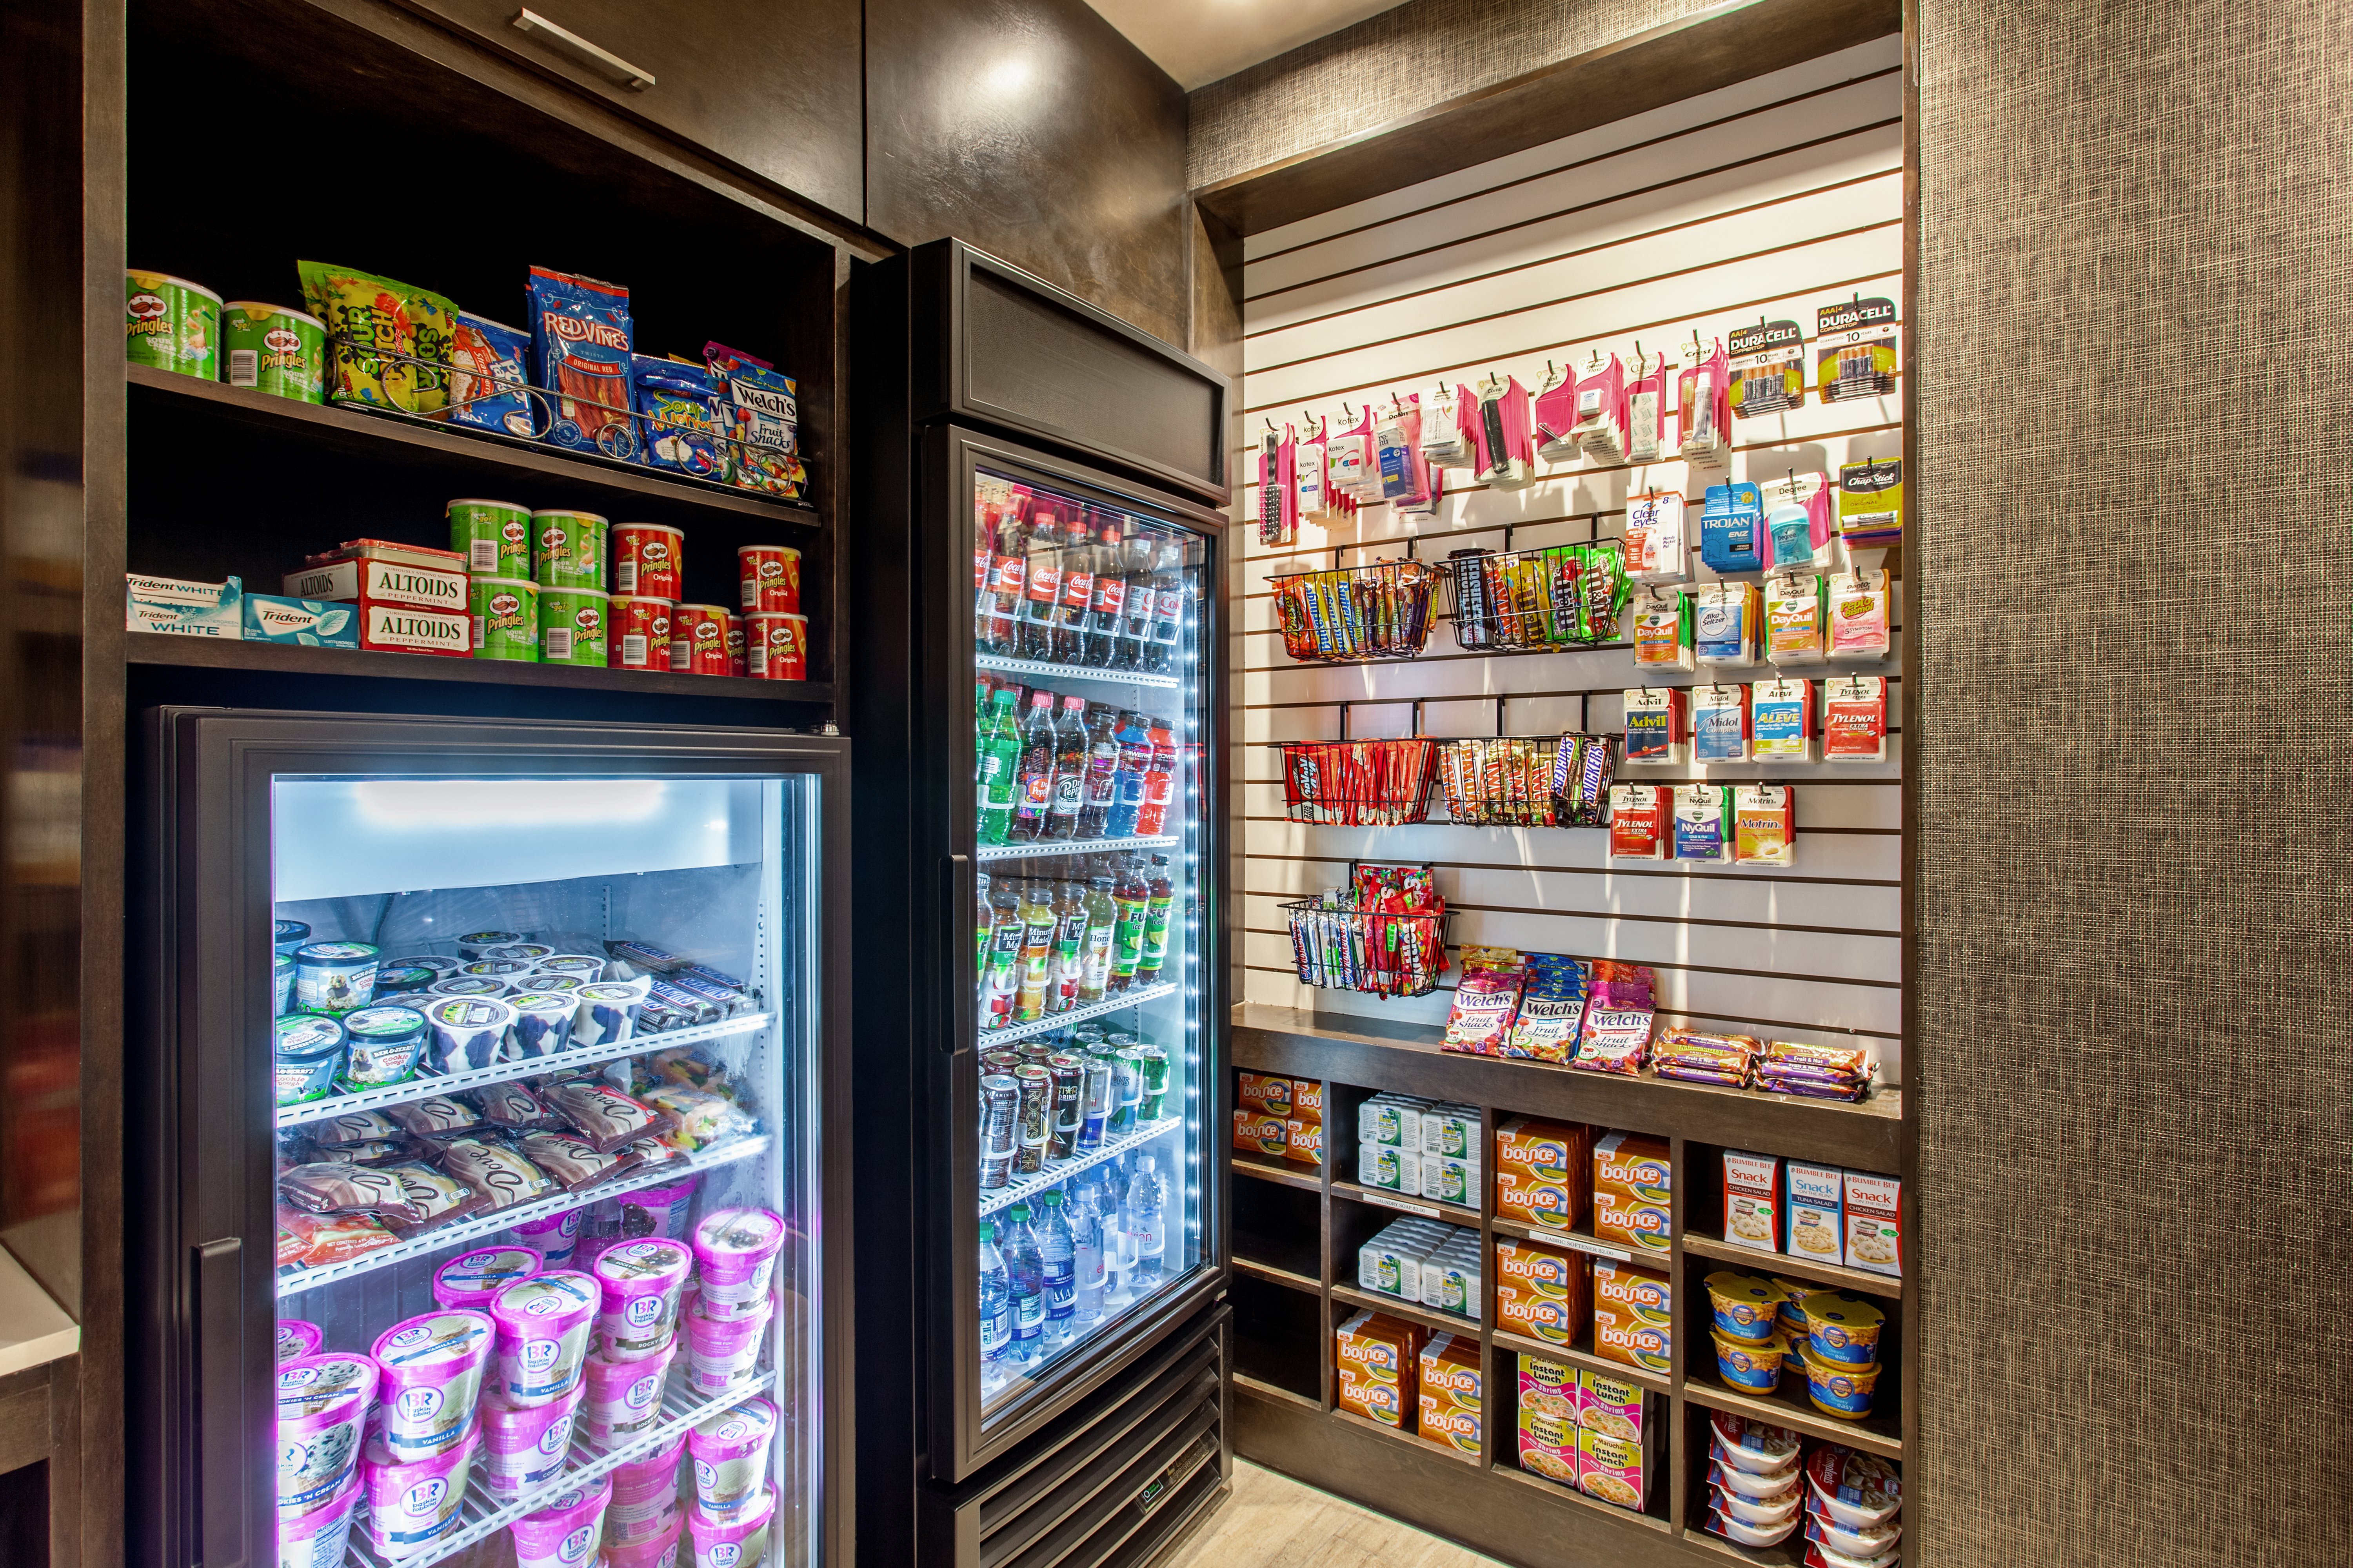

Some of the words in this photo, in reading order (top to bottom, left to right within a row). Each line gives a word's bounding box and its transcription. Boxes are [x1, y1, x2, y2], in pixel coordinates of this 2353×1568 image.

[1819, 305, 1891, 328] DURACELL
[1820, 322, 1857, 332] COPPERTOP
[349, 308, 379, 374] SOUR
[1731, 328, 1796, 350] DURACELL
[1846, 332, 1860, 342] 10
[1731, 344, 1764, 354] COPPERTOP
[261, 354, 307, 372] Pringles
[574, 358, 600, 372] ORIGINAL
[1755, 354, 1767, 364] 10
[654, 391, 705, 416] Sour
[736, 386, 796, 416] Welch's
[760, 424, 785, 437] Fruit
[751, 432, 791, 449] Snacks
[1779, 485, 1806, 494] Degree
[1633, 508, 1659, 520] Clear
[1634, 517, 1658, 528] eyes
[1702, 517, 1750, 528] TROJAN
[540, 546, 571, 566] Pringles
[642, 559, 671, 575] Pringles
[127, 578, 175, 590] Trident
[177, 586, 223, 597] WHITE
[301, 574, 333, 596] ALTOIDS
[379, 572, 458, 598] ALTOIDS
[760, 577, 786, 592] Pringles
[388, 593, 449, 605] PEPPERMINT
[1841, 598, 1874, 612] Pepto-
[139, 611, 178, 621] Trident
[262, 611, 313, 624] Trident
[1845, 604, 1874, 618] Bismol
[487, 615, 524, 633] Pringles
[1703, 617, 1725, 626] Seltzer
[1771, 613, 1813, 624] DayQuil
[151, 623, 220, 635] WHITE
[381, 617, 460, 639] ALTOIDS
[1637, 627, 1673, 637] DayQuil
[390, 637, 451, 647] PEPPERMINT
[574, 628, 603, 646] Pringles
[694, 638, 721, 655] Pringles
[769, 644, 795, 659] Pringles
[1628, 716, 1666, 726] Advil
[1758, 713, 1800, 723] ALEVE
[1833, 715, 1876, 723] TYLENOL
[1615, 819, 1653, 828] TYLENOL
[1682, 824, 1715, 833] NyQuil
[1741, 819, 1778, 829] Motrin
[1459, 993, 1511, 1007] Welch's
[1527, 1002, 1580, 1016] Welch's
[1459, 1020, 1494, 1028] Snacks
[1594, 1014, 1651, 1027] Welch's
[1591, 1040, 1630, 1048] Snacks
[1244, 1085, 1283, 1098] bounce
[1379, 1114, 1391, 1123] Ares
[1238, 1123, 1277, 1138] bounce
[1503, 1144, 1554, 1164] bounce
[1732, 1158, 1759, 1168] BUMBLE
[1602, 1162, 1658, 1182] bounce
[1732, 1169, 1766, 1184] Snack
[1796, 1167, 1824, 1178] BUMBLE
[1796, 1179, 1833, 1195] Snack
[1376, 1198, 1398, 1208] LAUNDRY
[1504, 1187, 1555, 1206] bounce
[1852, 1189, 1891, 1204] Snack
[1545, 1236, 1566, 1246] FABRIC
[1567, 1241, 1597, 1252] SOFTENER
[426, 1339, 457, 1352] VANILLA
[1530, 1362, 1565, 1377] Instant
[1534, 1371, 1561, 1384] Lunch
[541, 1381, 569, 1393] VANILLA
[1538, 1385, 1561, 1394] Shrimp
[1536, 1418, 1563, 1429] Maruchan
[1530, 1423, 1564, 1439] Instant
[422, 1431, 455, 1445] VANILLA
[1534, 1432, 1561, 1446] Lunch
[1538, 1443, 1561, 1455] Shrimp
[315, 1481, 341, 1497] CREAM
[412, 1498, 437, 1508] baskin
[412, 1502, 438, 1512] robbins
[427, 1516, 455, 1536] VANILLA
